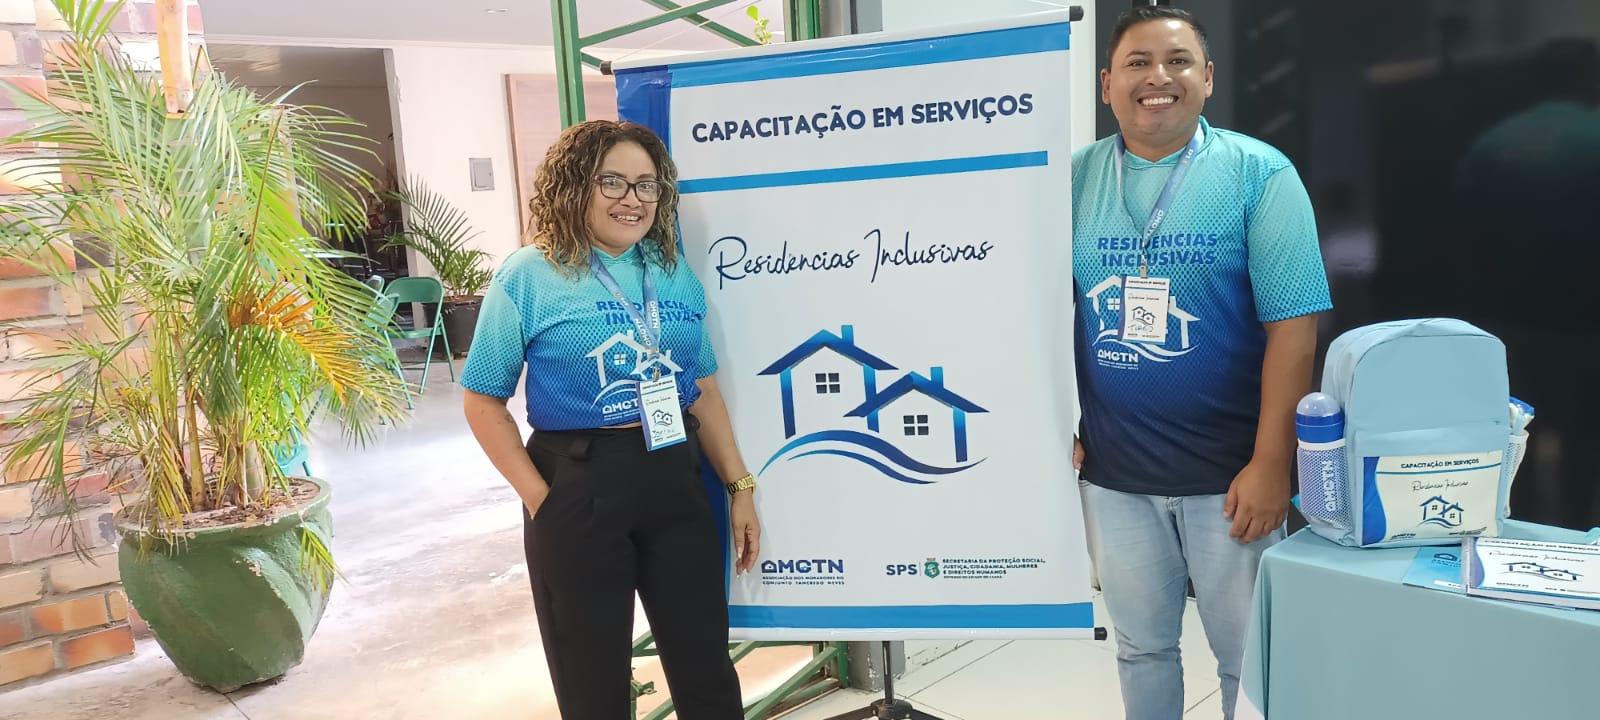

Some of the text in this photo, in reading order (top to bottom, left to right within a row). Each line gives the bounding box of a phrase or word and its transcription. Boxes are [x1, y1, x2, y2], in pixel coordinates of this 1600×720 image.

[692, 93, 1033, 143] CAPACITAÇÃO EM SERVIÇOS
[708, 228, 994, 290] Residencias Inclusivas
[602, 397, 639, 414] AMCT
[1400, 460, 1444, 469] CAPACITAÇÃO
[886, 564, 917, 575] SPS
